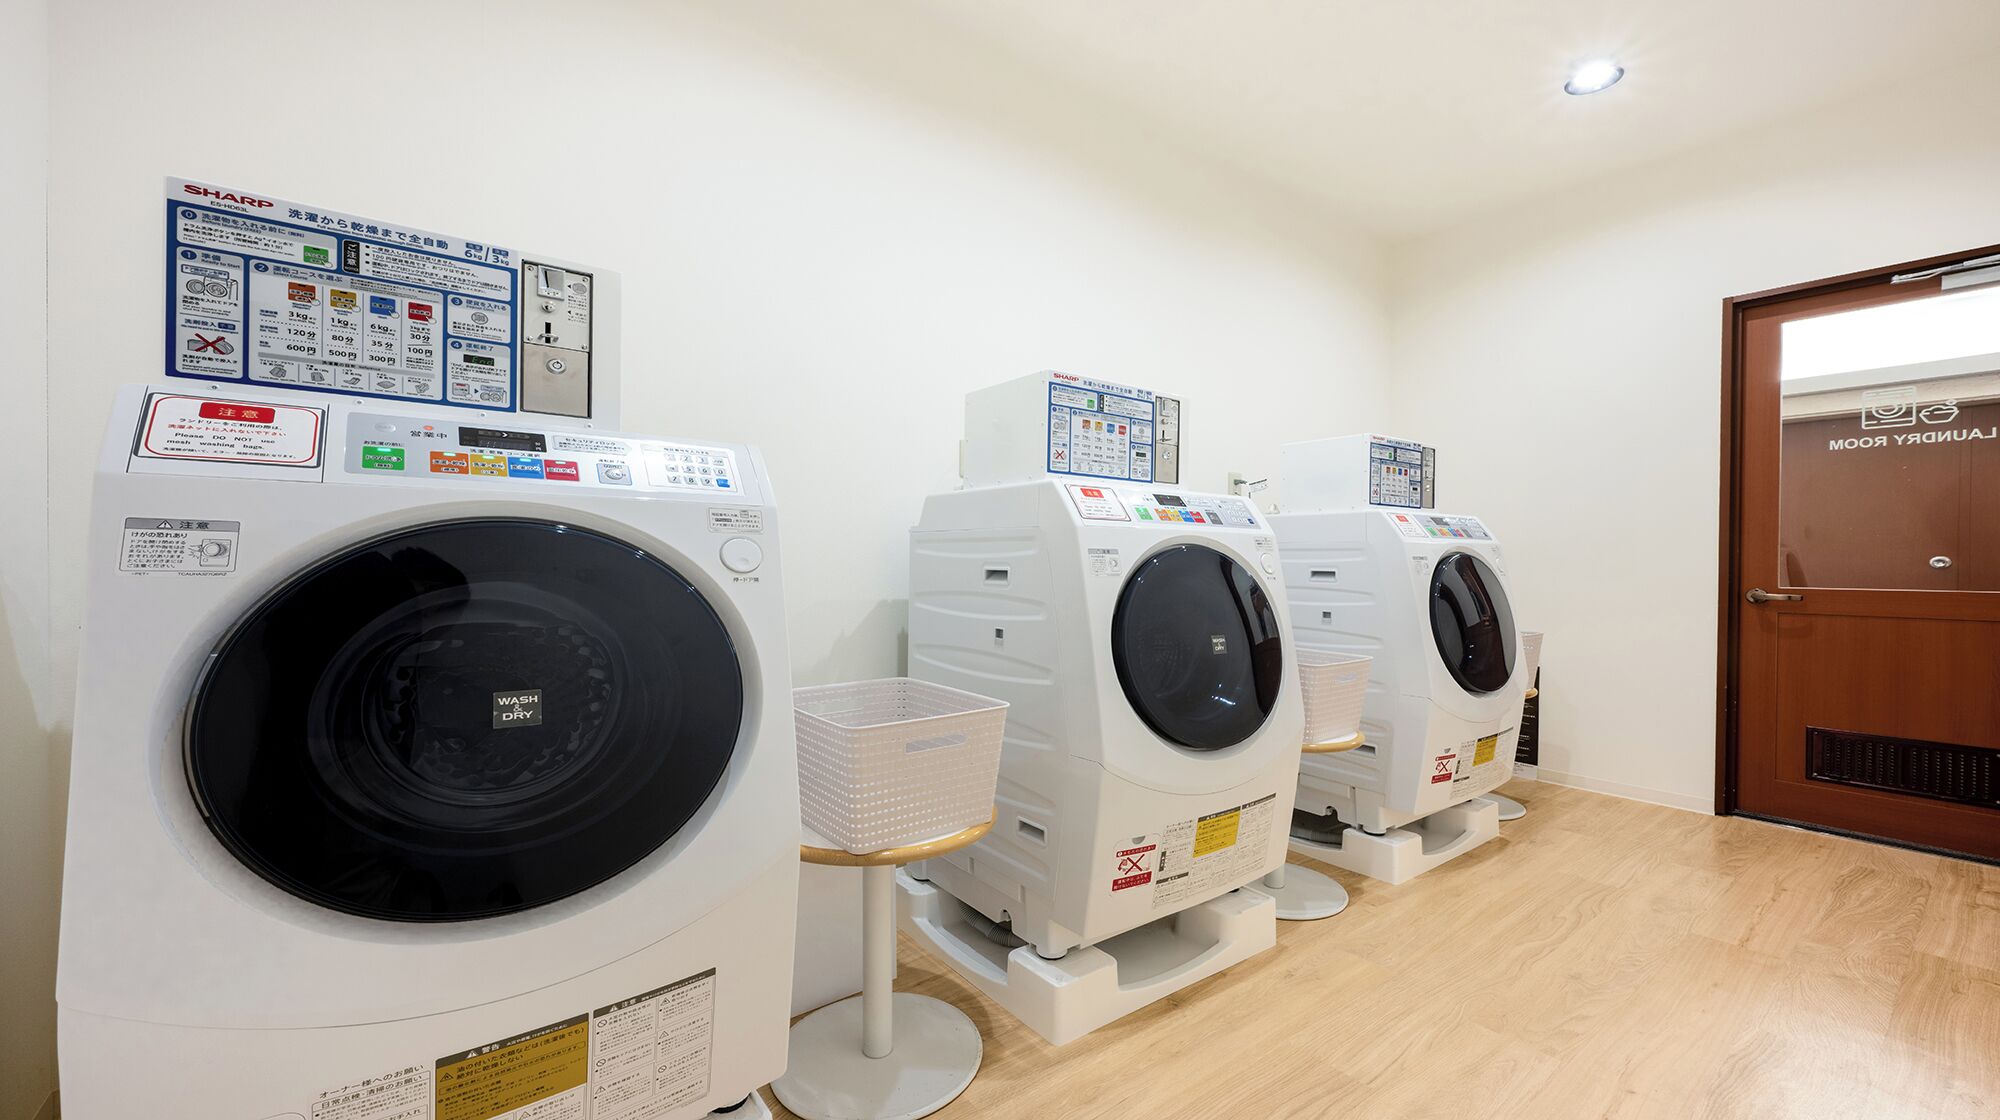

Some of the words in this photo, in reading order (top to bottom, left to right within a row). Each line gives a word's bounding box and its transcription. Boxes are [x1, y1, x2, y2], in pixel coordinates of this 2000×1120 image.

[184, 184, 274, 208] SHARP
[210, 201, 249, 213] ES-HD63L
[202, 212, 286, 235] 洗濯物を入れる前に
[288, 208, 448, 250] 洗濯から乾燥まで全自動
[296, 311, 308, 320] kg
[378, 323, 389, 332] kg
[218, 407, 260, 419] 注意
[168, 423, 287, 437] 洗濯ネットに入れないで下さい
[410, 430, 447, 438] 営業中
[174, 432, 204, 440] Please
[166, 438, 191, 446] mesh
[200, 441, 235, 449] washing
[179, 521, 210, 529] 注意
[130, 531, 188, 539] けがの恐れあり
[497, 695, 538, 706] WASH
[513, 703, 523, 712] &
[502, 710, 533, 721] DRY
[481, 1043, 500, 1054] 警告
[456, 1054, 524, 1080] 絶対に乾燥しない
[319, 1064, 424, 1099] オーナー様へのお願い
[321, 1075, 423, 1109] 日常点検・清掃のお願い
